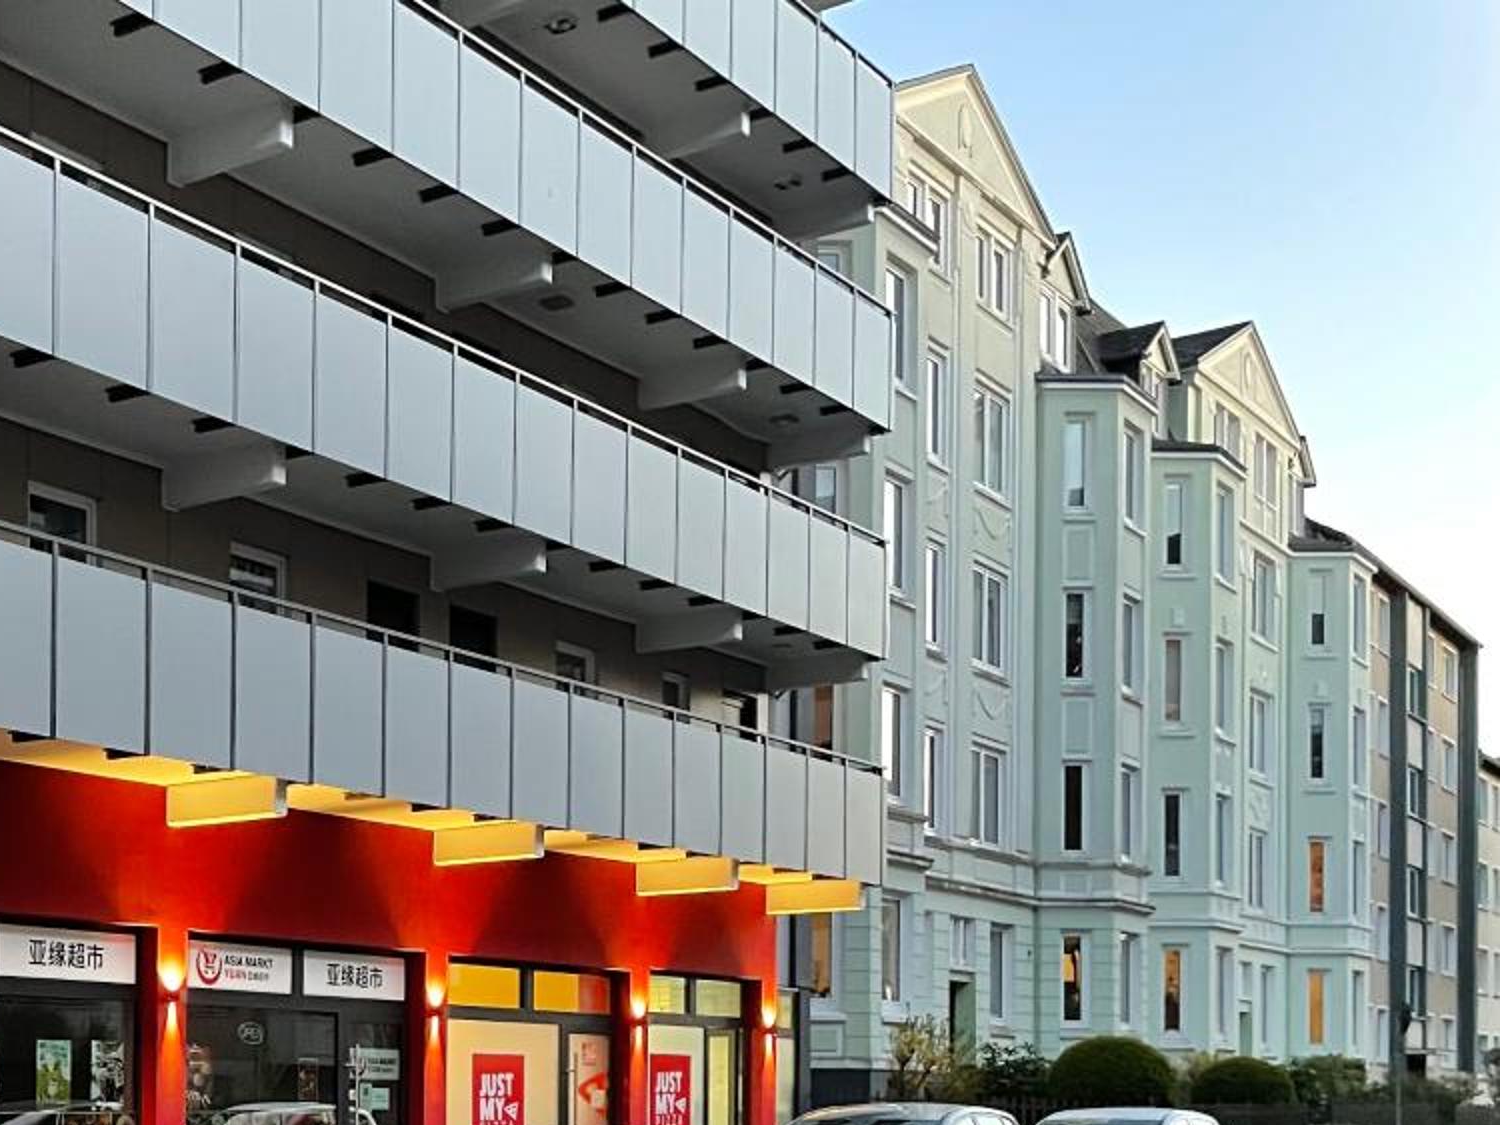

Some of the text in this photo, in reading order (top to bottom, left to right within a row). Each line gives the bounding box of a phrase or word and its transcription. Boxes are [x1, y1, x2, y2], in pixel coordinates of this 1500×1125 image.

[28, 938, 105, 970] 亚缘超市
[224, 954, 273, 969] ASIA MARKT
[326, 963, 383, 989] 亚缘超市
[480, 1073, 515, 1097] JUST
[656, 1071, 683, 1093] JUST
[480, 1097, 505, 1120] MY
[656, 1093, 676, 1114] MY
